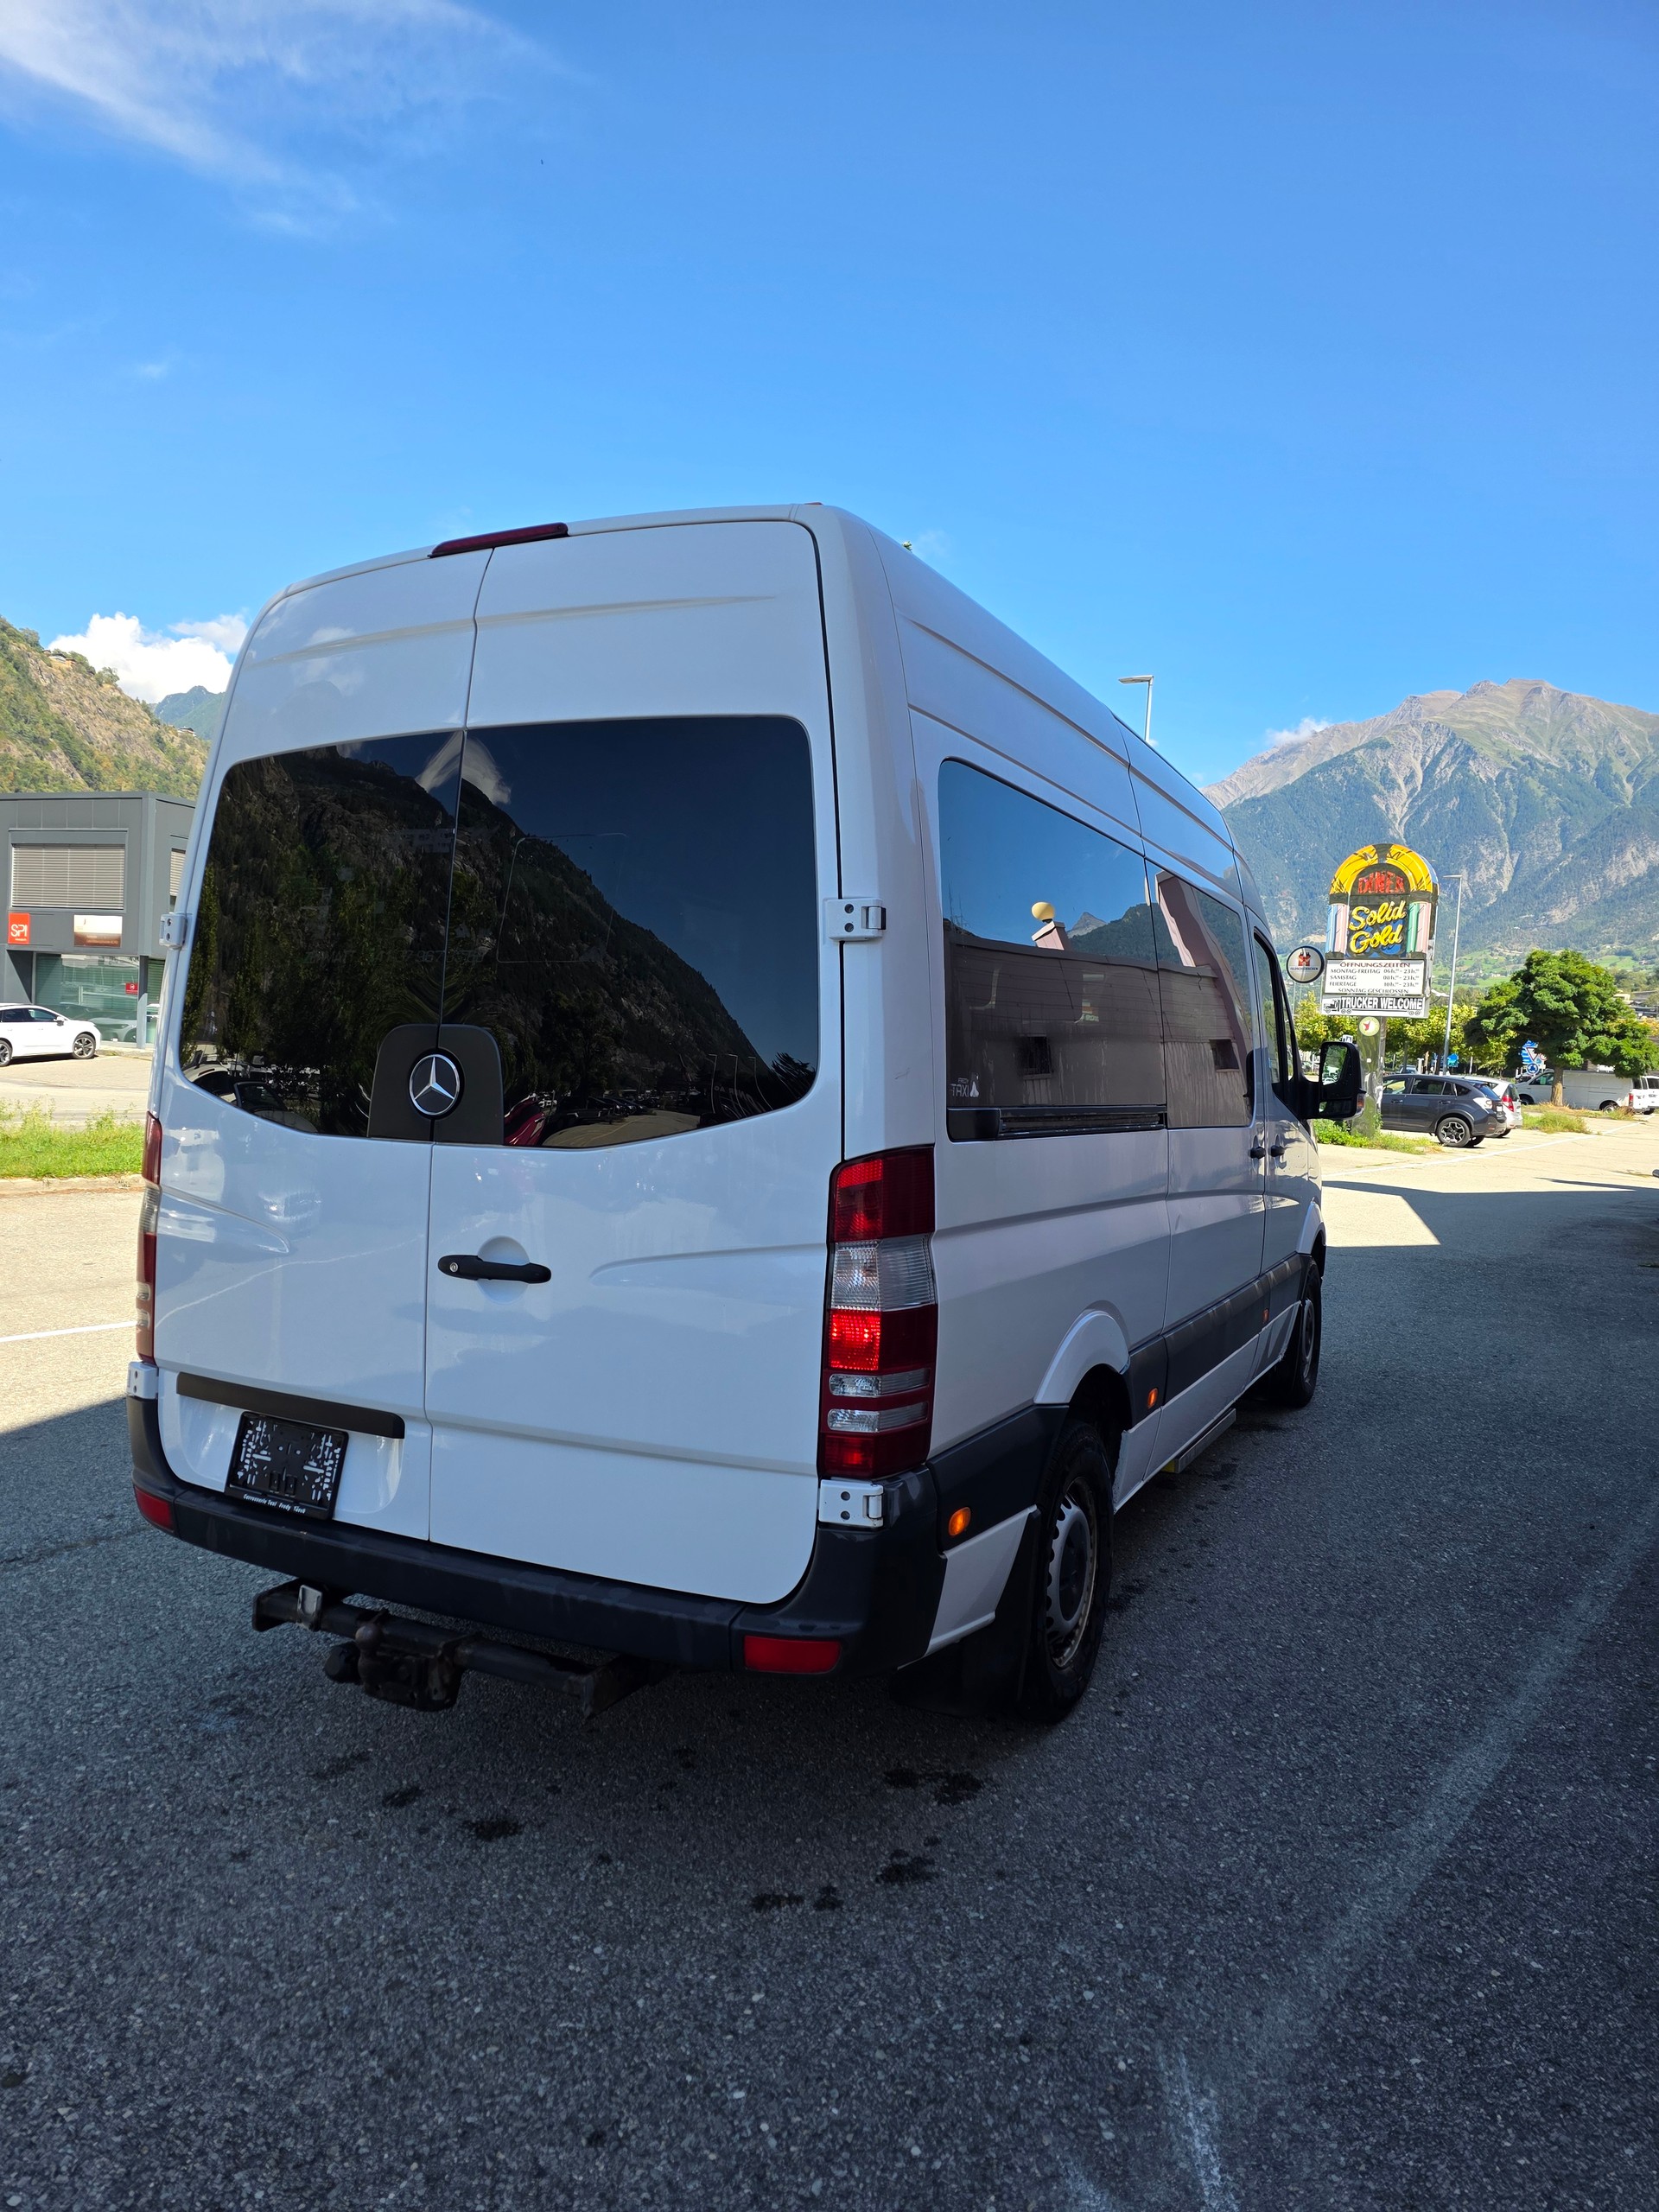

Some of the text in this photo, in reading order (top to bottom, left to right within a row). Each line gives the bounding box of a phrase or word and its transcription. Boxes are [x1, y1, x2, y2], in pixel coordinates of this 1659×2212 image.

[1357, 871, 1406, 893] DINER
[1349, 900, 1408, 931] Solid
[10, 924, 28, 937] SPI
[1350, 924, 1403, 954] Gold
[1341, 996, 1423, 1010] TRUCKER WELCOME
[950, 1084, 969, 1097] TAXI
